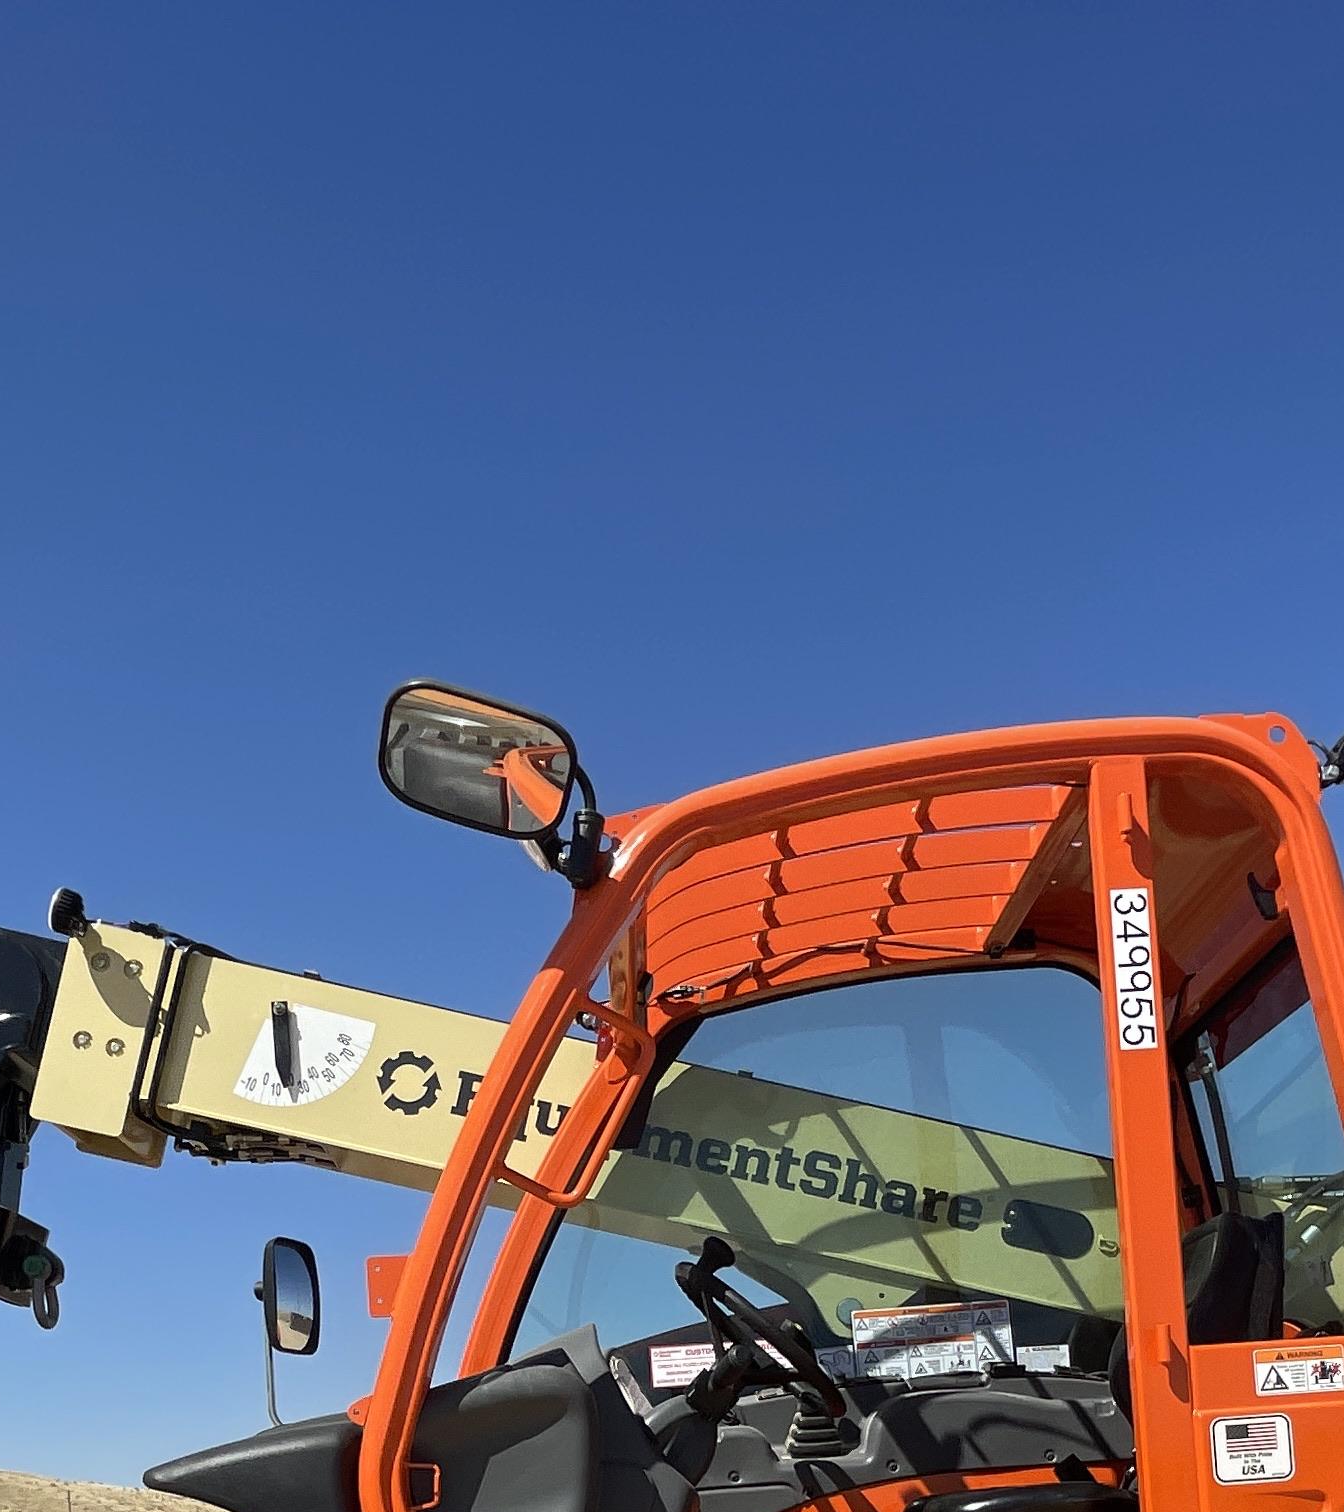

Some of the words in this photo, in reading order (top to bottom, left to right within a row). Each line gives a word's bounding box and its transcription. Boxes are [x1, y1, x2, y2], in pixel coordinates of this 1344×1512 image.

[1113, 892, 1156, 1046] 349955
[337, 1033, 353, 1046] 80
[324, 1052, 340, 1067] 60
[339, 1048, 355, 1062] 70
[262, 1072, 270, 1086] 0
[307, 1066, 320, 1081] 40
[321, 1067, 336, 1082] 50
[271, 1082, 282, 1098] 10
[1242, 1464, 1266, 1476] USA
